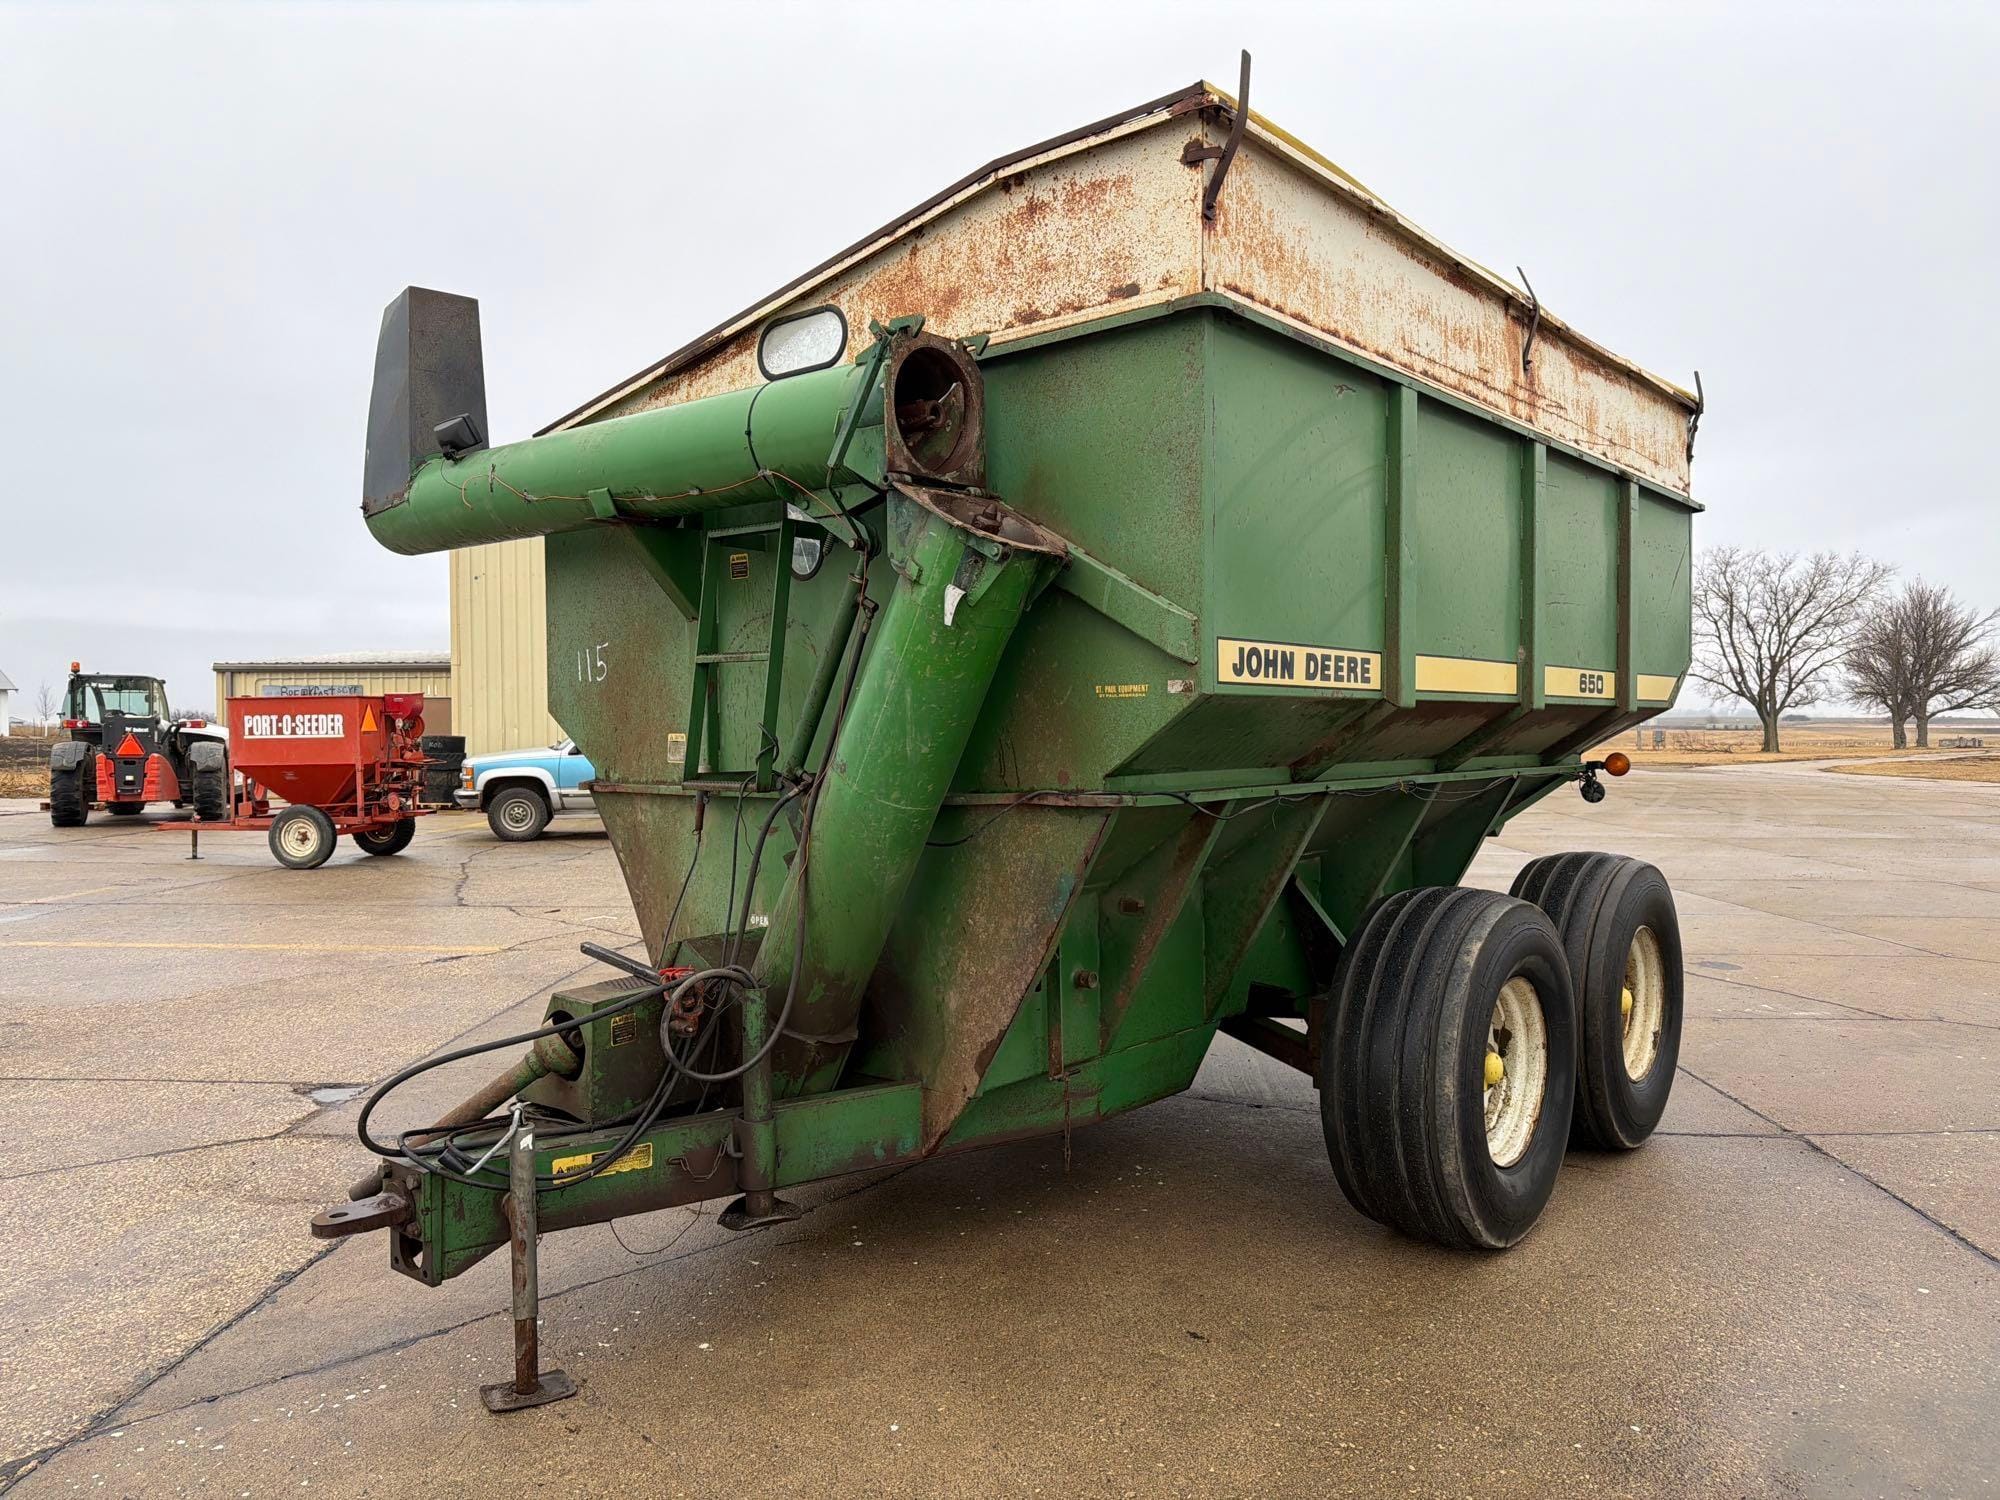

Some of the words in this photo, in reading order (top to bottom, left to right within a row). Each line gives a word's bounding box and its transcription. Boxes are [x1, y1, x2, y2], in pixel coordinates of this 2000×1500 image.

[577, 642, 609, 682] 115
[1232, 646, 1295, 680] JOHN
[1305, 652, 1371, 684] DEERE
[1118, 684, 1149, 693] EQUIPMENT
[1580, 673, 1604, 694] 650
[243, 714, 344, 735] PORT-O-SEEDER
